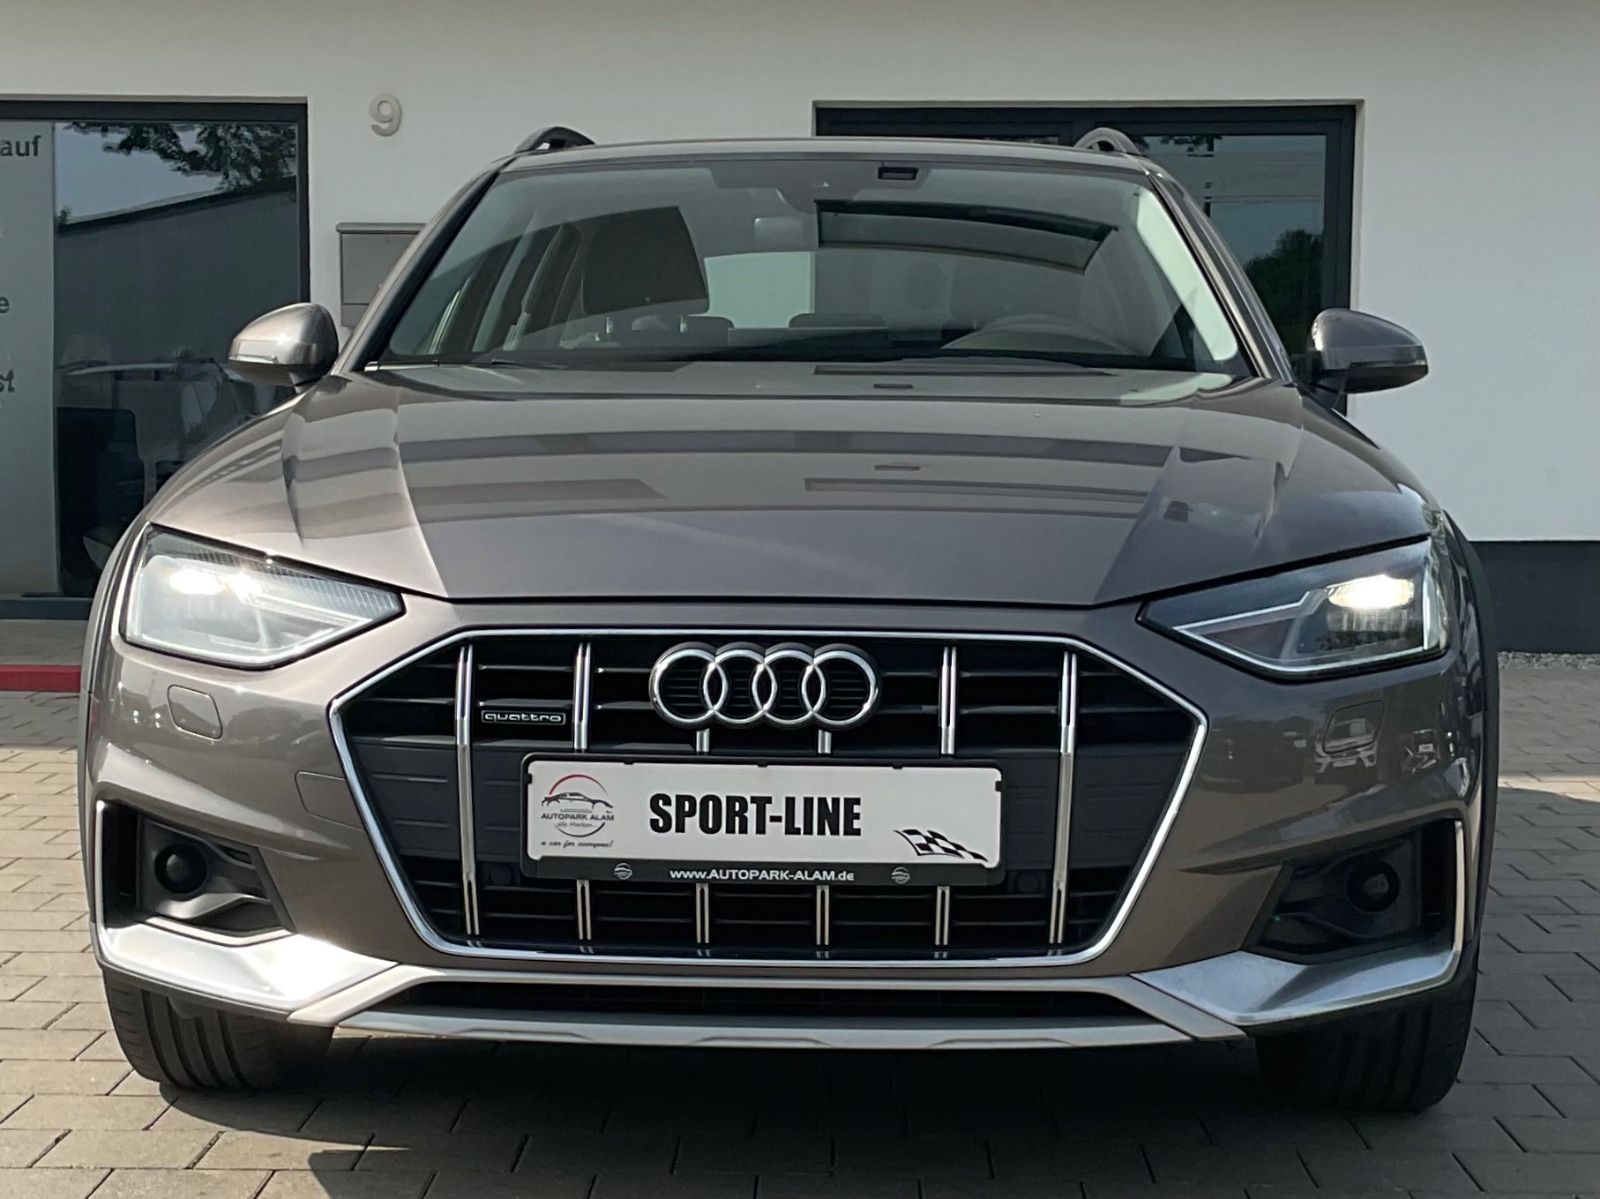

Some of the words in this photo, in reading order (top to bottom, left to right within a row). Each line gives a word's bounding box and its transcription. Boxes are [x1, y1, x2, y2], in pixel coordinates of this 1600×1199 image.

[368, 94, 402, 137] 9
[484, 713, 562, 722] quattro
[649, 792, 862, 837] SPORT-LINE
[669, 868, 855, 882] www.AUTOPARK-ALAM.de
